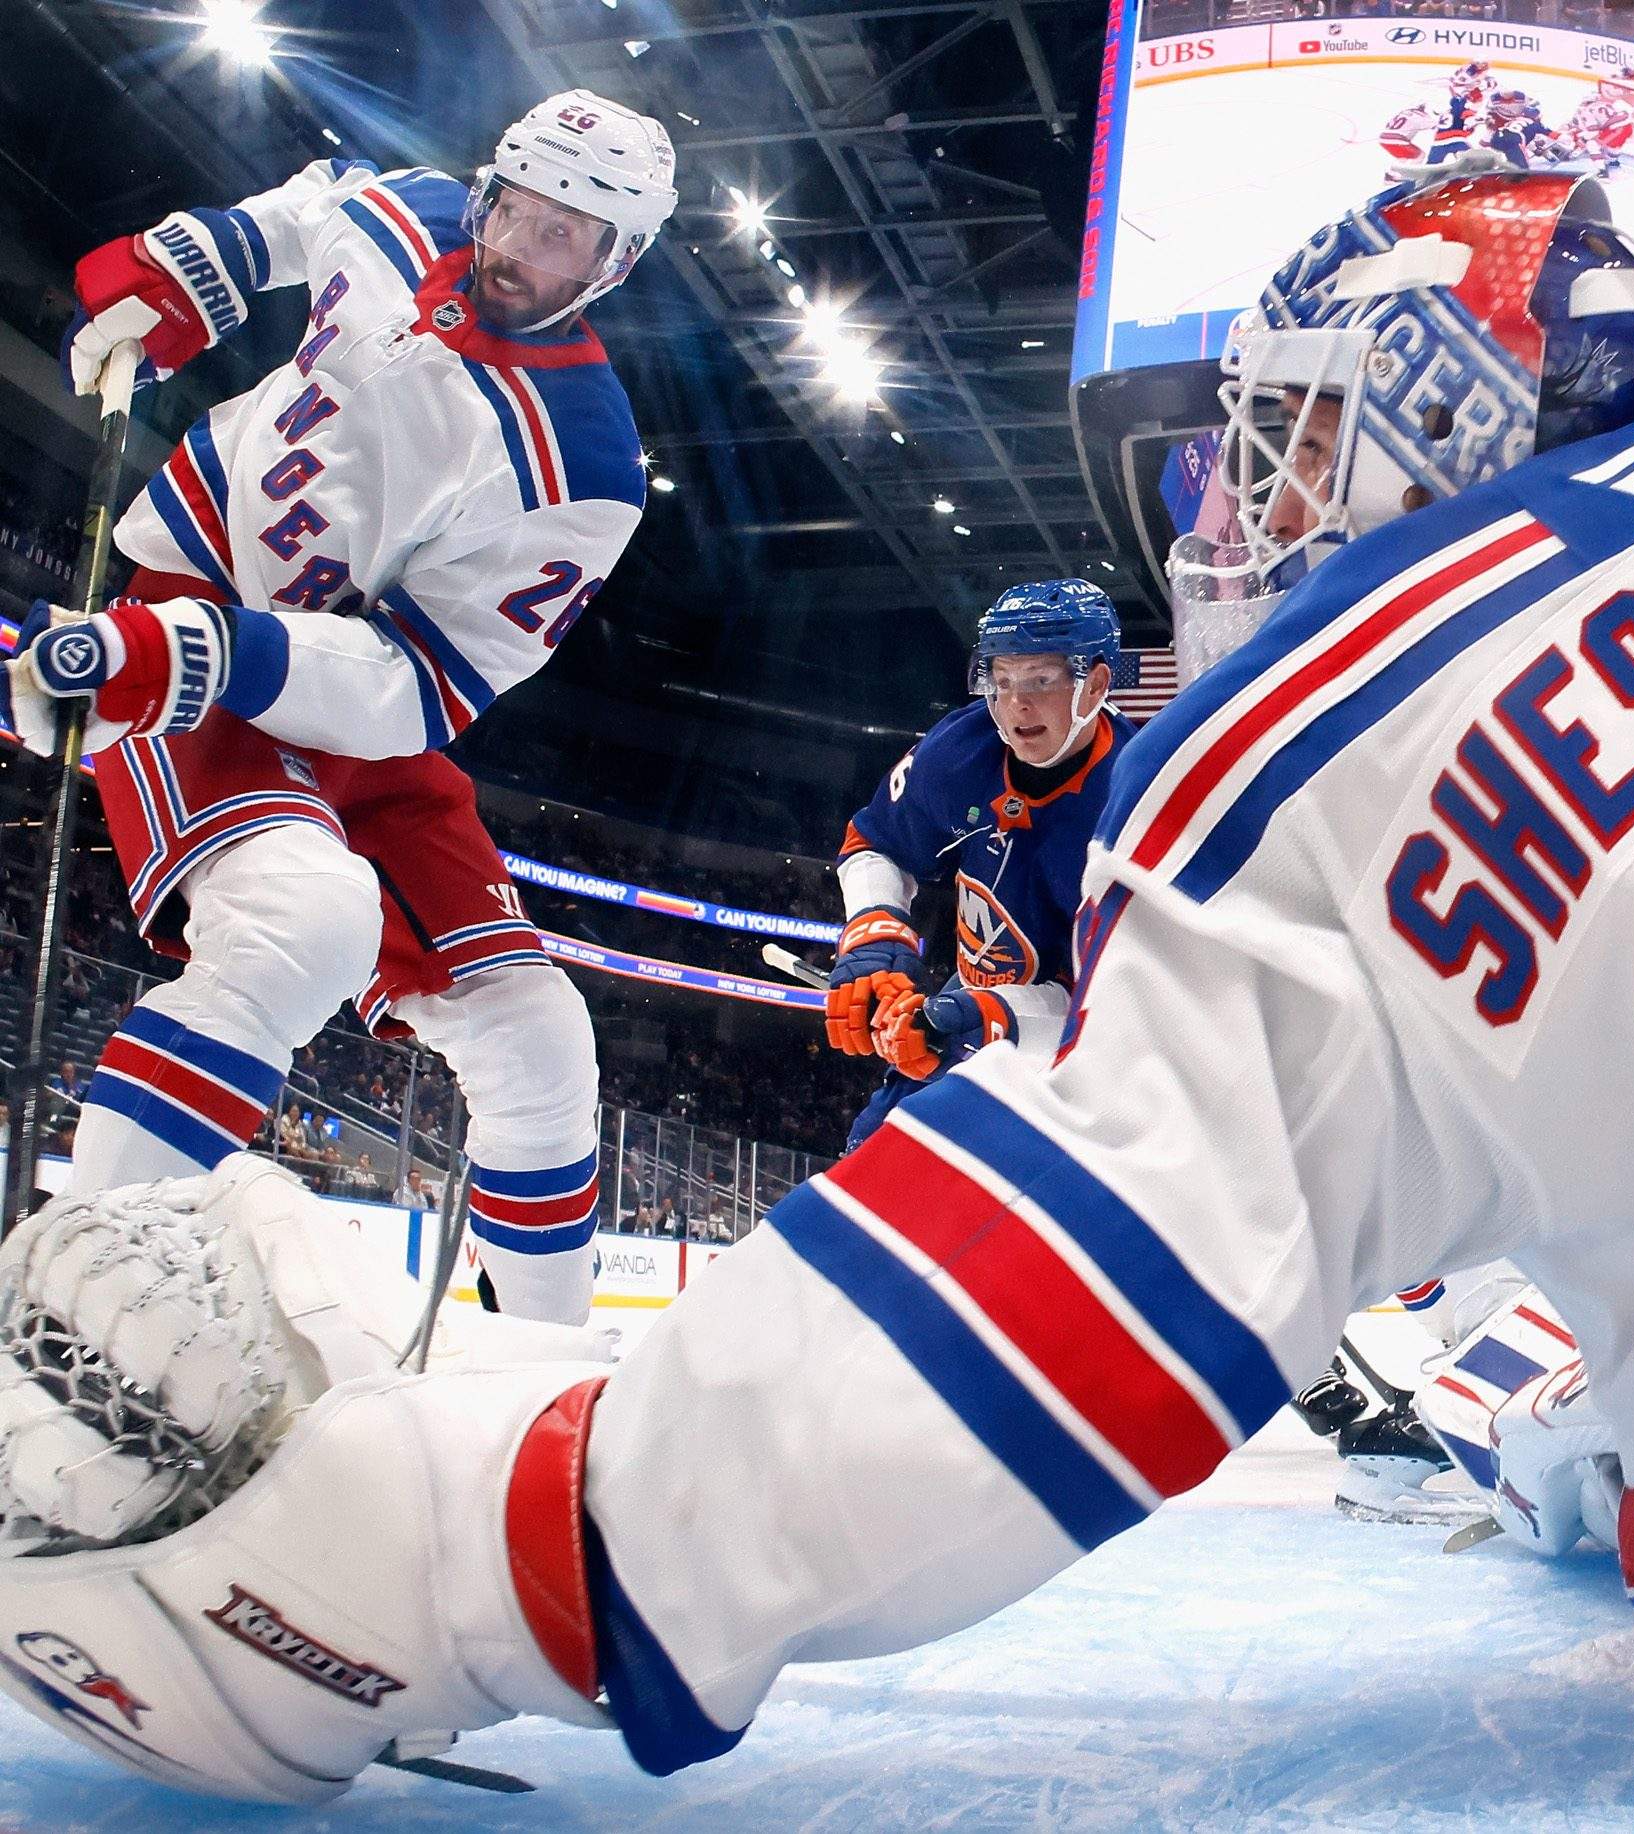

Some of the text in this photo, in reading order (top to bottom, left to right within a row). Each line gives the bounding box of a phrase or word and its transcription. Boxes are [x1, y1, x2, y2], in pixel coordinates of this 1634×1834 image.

[1148, 38, 1215, 67] UBS
[1323, 40, 1368, 51] YouTube
[1434, 29, 1540, 52] HYUNDAI
[1089, 40, 1120, 193] RICHARD
[534, 135, 581, 159] WARRIOR
[1079, 226, 1101, 299] SON
[496, 560, 604, 650] 26
[986, 625, 1018, 635] BAUER
[503, 855, 628, 901] CAN YOU IMAGINE?
[715, 909, 745, 928] CAN
[745, 914, 777, 932] YOU
[638, 963, 682, 980] PLAY TODAY
[604, 1251, 656, 1275] VANDA
[215, 1591, 403, 1704] KRYPTIK
